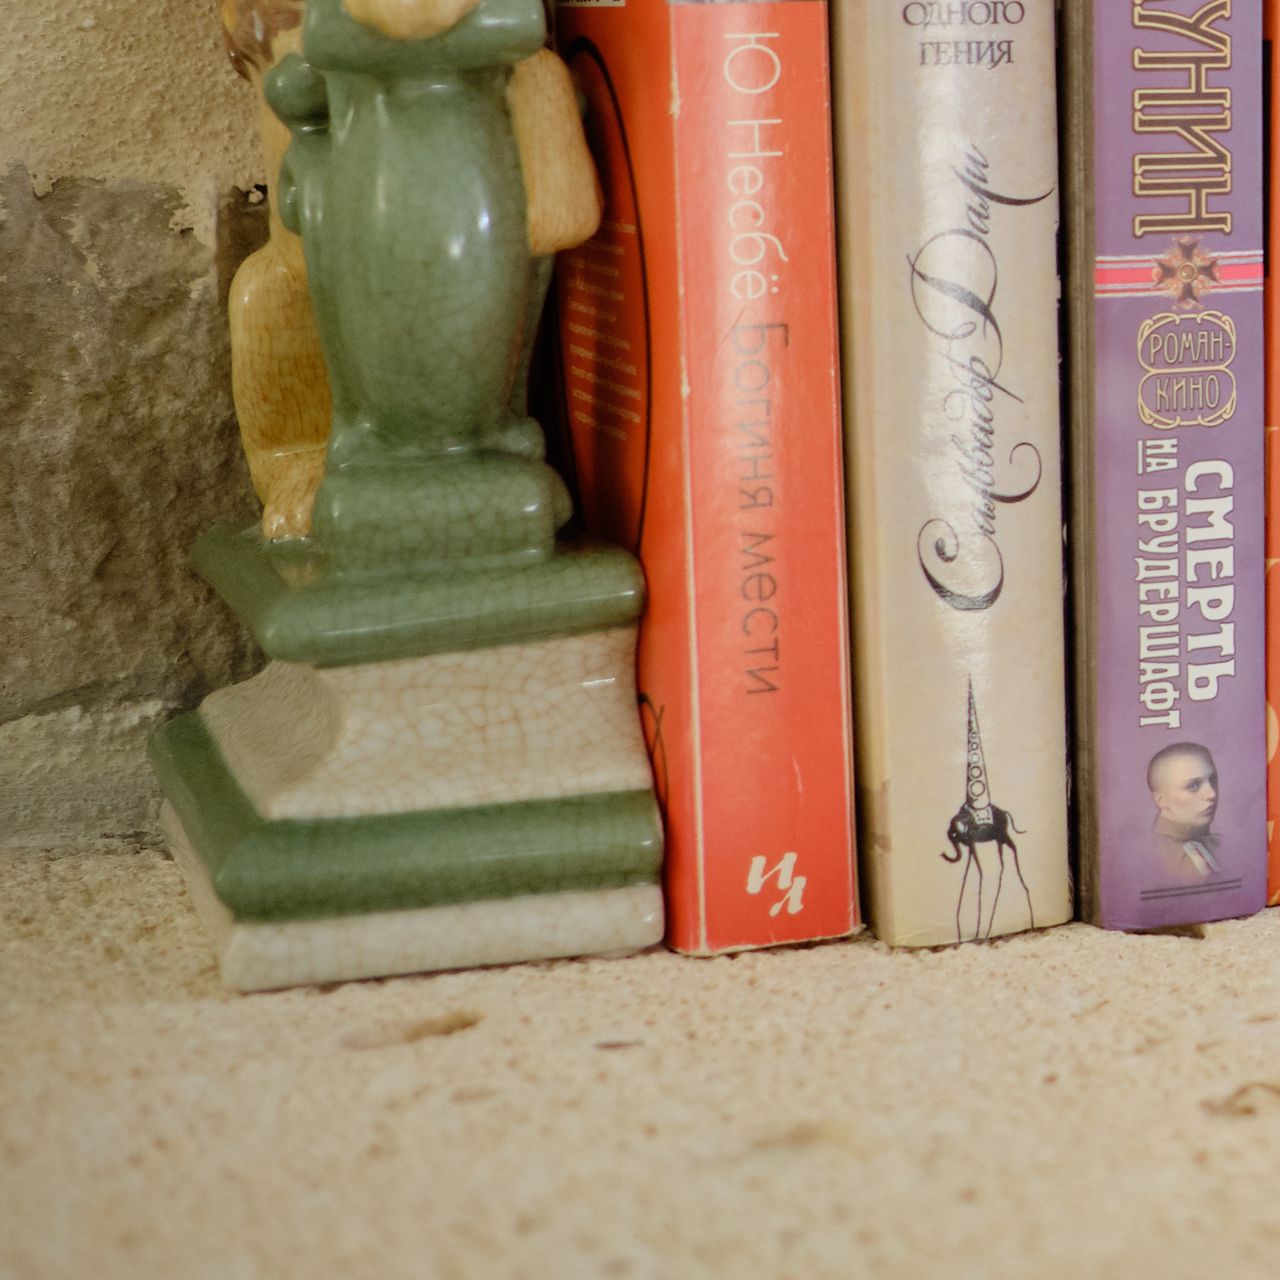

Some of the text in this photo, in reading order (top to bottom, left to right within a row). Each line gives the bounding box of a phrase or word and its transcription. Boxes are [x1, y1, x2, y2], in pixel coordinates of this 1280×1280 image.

[903, 0, 1025, 29] ОДНОГО
[919, 40, 1014, 70] ГЕНИЯ
[723, 32, 788, 300] Ю Несбё
[906, 142, 1055, 611] Сальвадор Дали
[1150, 328, 1231, 366] РОМАН-
[1155, 373, 1220, 413] КИНО
[731, 321, 790, 698] Богиня мести
[1135, 437, 1181, 729] НА БРУДЕРШАФТ
[1185, 459, 1236, 702] СМЕРТЬ
